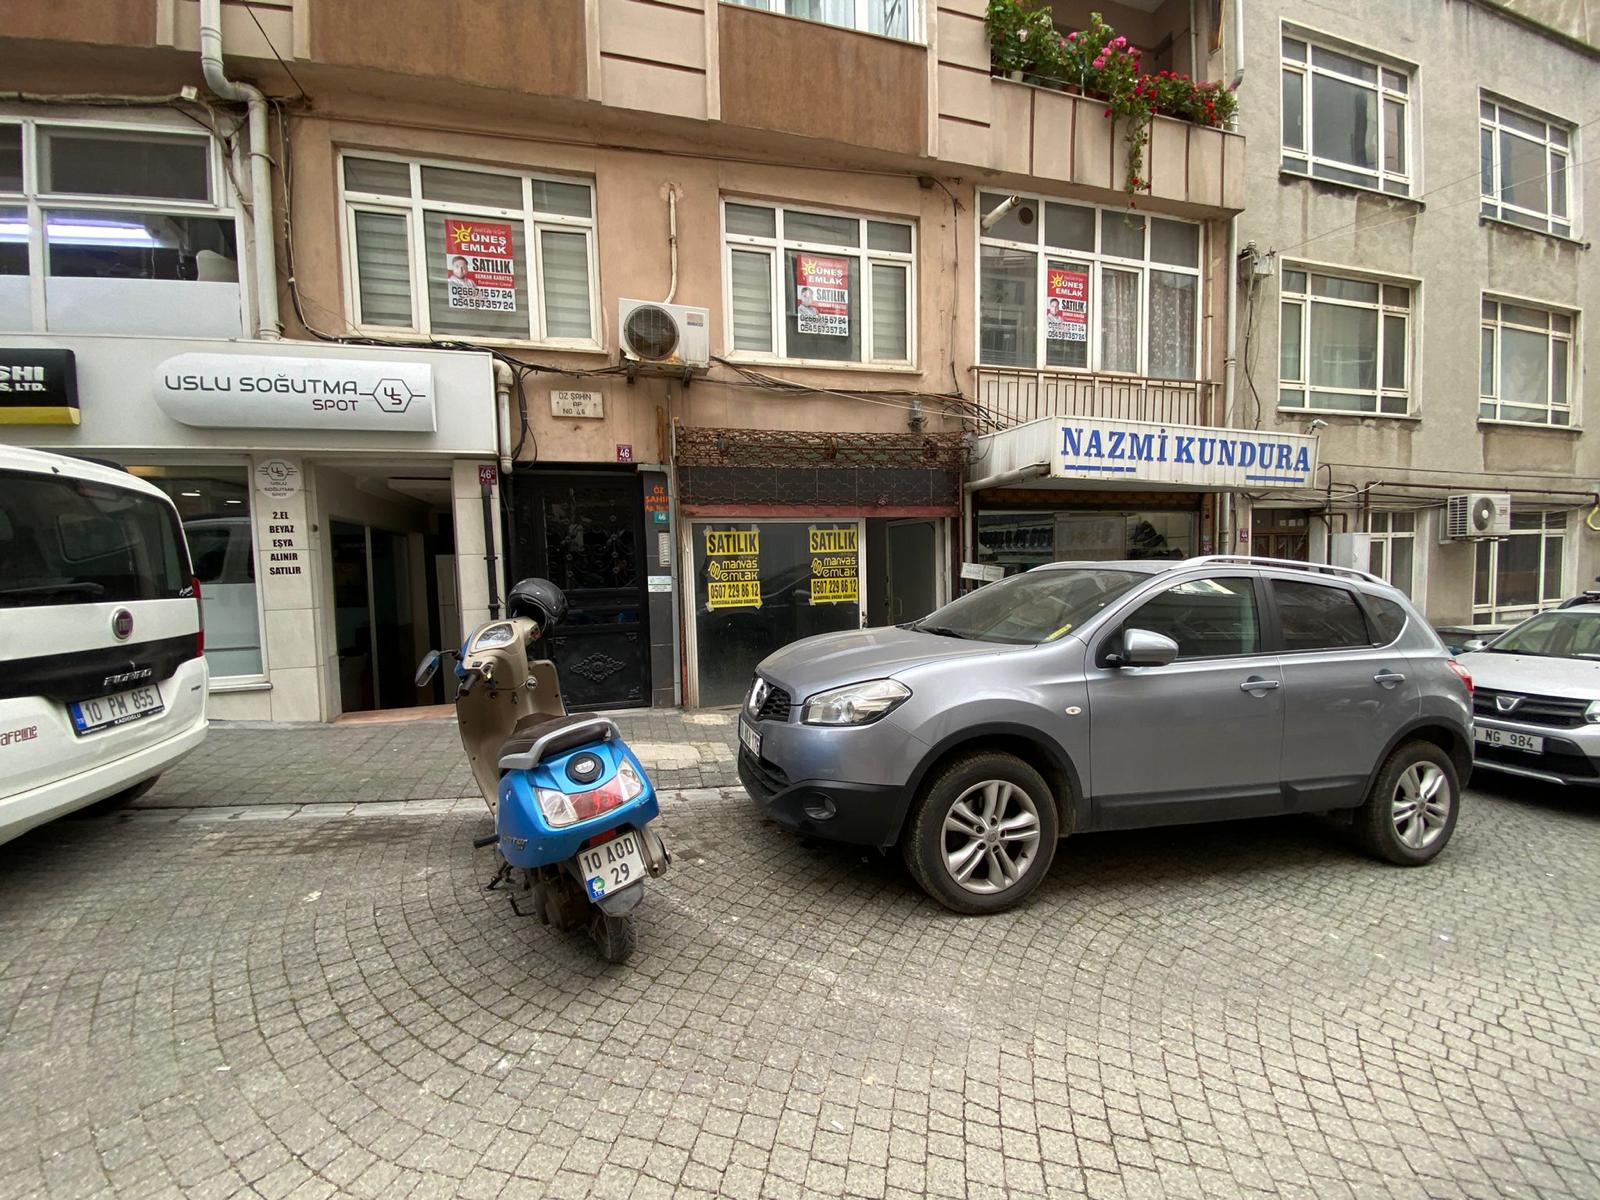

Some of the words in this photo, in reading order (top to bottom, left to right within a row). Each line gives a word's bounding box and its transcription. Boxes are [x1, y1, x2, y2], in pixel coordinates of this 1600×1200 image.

[461, 242, 507, 255] EMLAK
[472, 257, 511, 274] SATILIK
[808, 275, 843, 286] EMLAK
[816, 289, 846, 303] SATILIK
[1055, 287, 1083, 297] EMLAK
[1061, 299, 1085, 312] SATILIK
[15, 382, 47, 392] LTD.
[164, 375, 231, 392] USLU
[239, 373, 358, 395] SOĞUTMA
[312, 399, 359, 412] SPOT
[619, 447, 630, 458] 46
[1060, 426, 1169, 462] NAZMİ
[1174, 434, 1310, 472] KUNDURA
[269, 525, 295, 534] BEYAZ
[272, 539, 294, 549] EŞYA
[708, 533, 757, 554] SATILIK
[811, 531, 856, 551] SATILIK
[270, 552, 298, 562] ALINIR
[269, 566, 301, 576] SATILIR
[710, 583, 726, 599] 0507
[728, 583, 740, 598] 229
[751, 582, 759, 597] 12
[813, 579, 827, 594] 0507
[828, 578, 840, 594] 229
[849, 577, 857, 593] 12
[85, 702, 103, 724] 10
[107, 695, 129, 717] PM
[131, 688, 154, 709] 855
[1485, 730, 1501, 743] NG
[1510, 733, 1534, 749] 984
[583, 852, 602, 874] 10
[610, 862, 630, 885] 29
